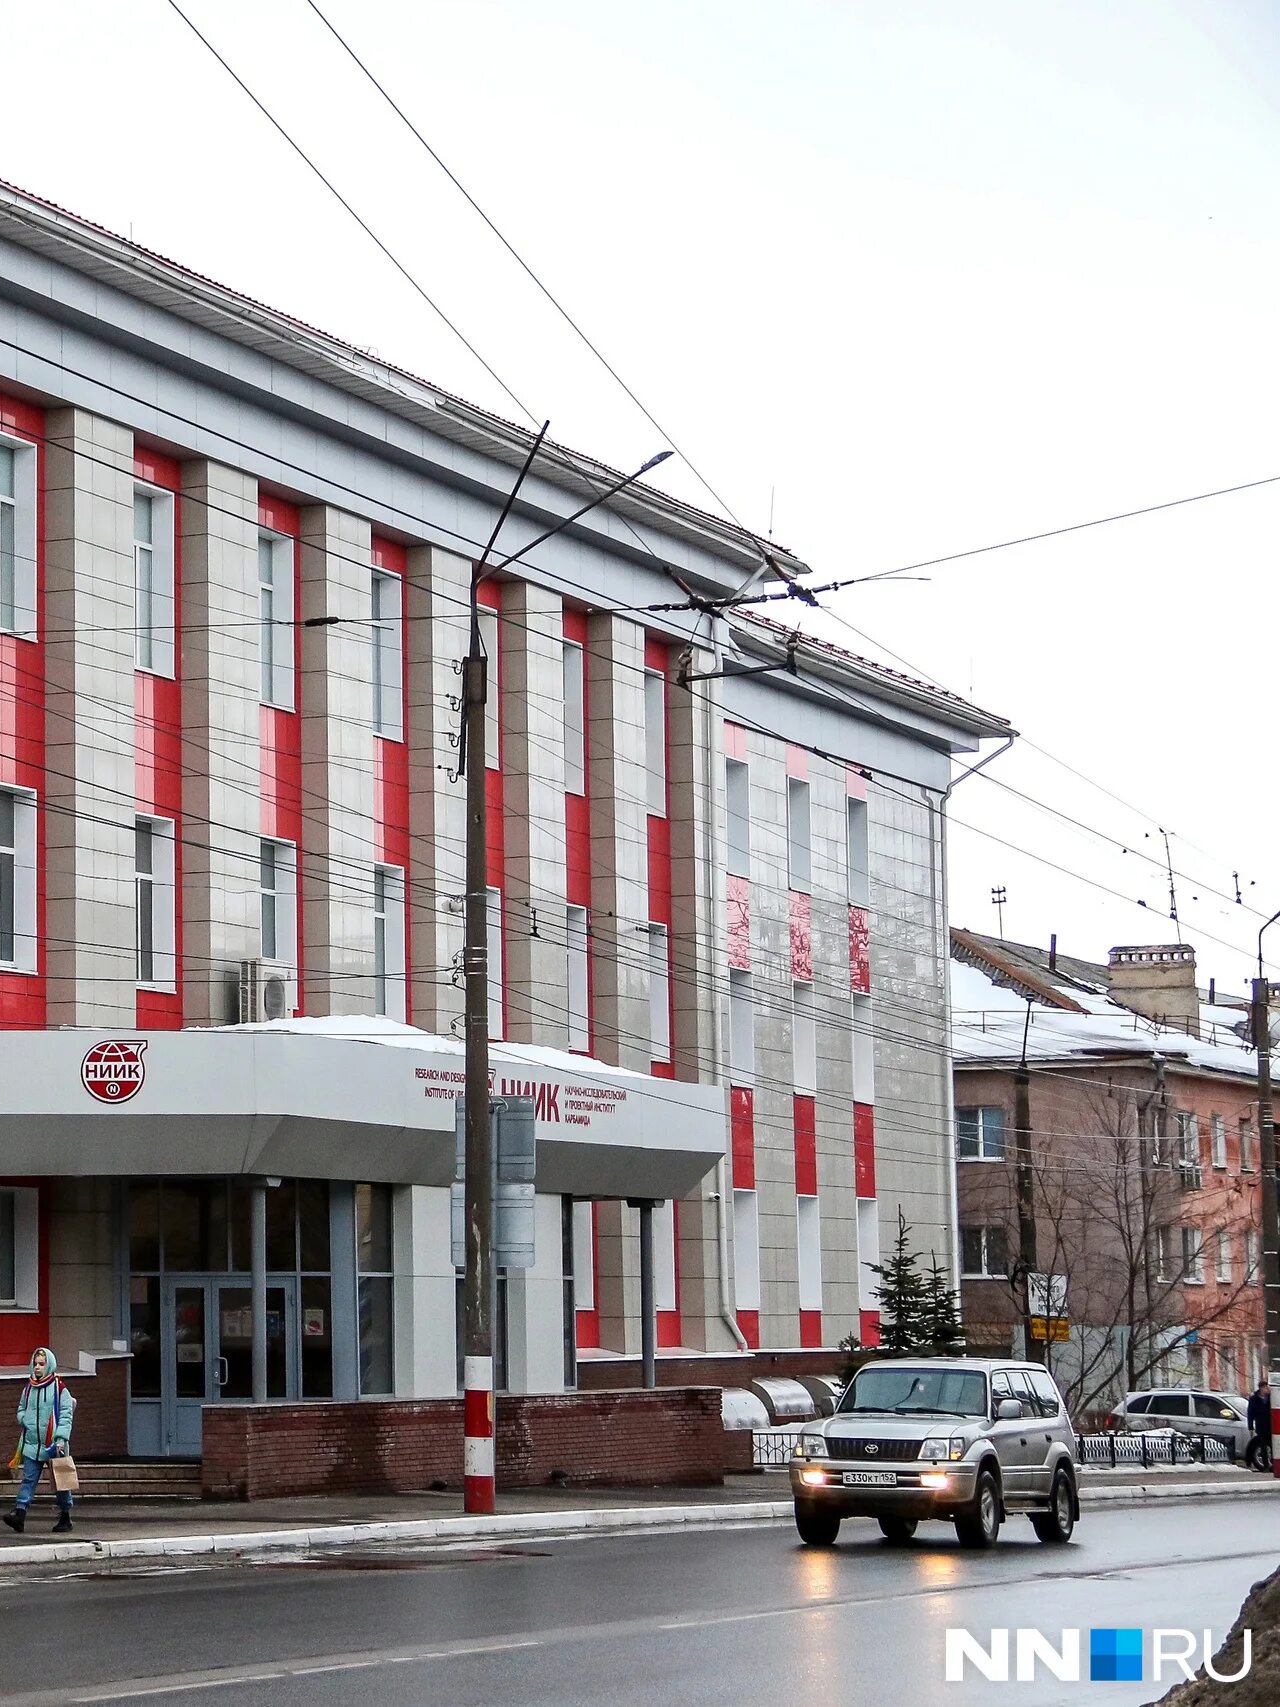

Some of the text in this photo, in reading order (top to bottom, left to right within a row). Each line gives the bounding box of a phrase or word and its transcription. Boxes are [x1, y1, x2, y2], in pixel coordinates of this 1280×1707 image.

[86, 1065, 140, 1078] НИИК
[415, 1068, 466, 1083] RESEARCH AND DESIG
[425, 1087, 447, 1099] INSTITUTE
[448, 1089, 454, 1100] OF
[565, 1085, 626, 1100] НАУЧНО-ИССЛЕДОВАТЕЛЬСКИЙ
[565, 1100, 615, 1113] И ПРОЕКТНЫЙ ИНСТИТУТ
[565, 1114, 590, 1126] КАРБАМИДА
